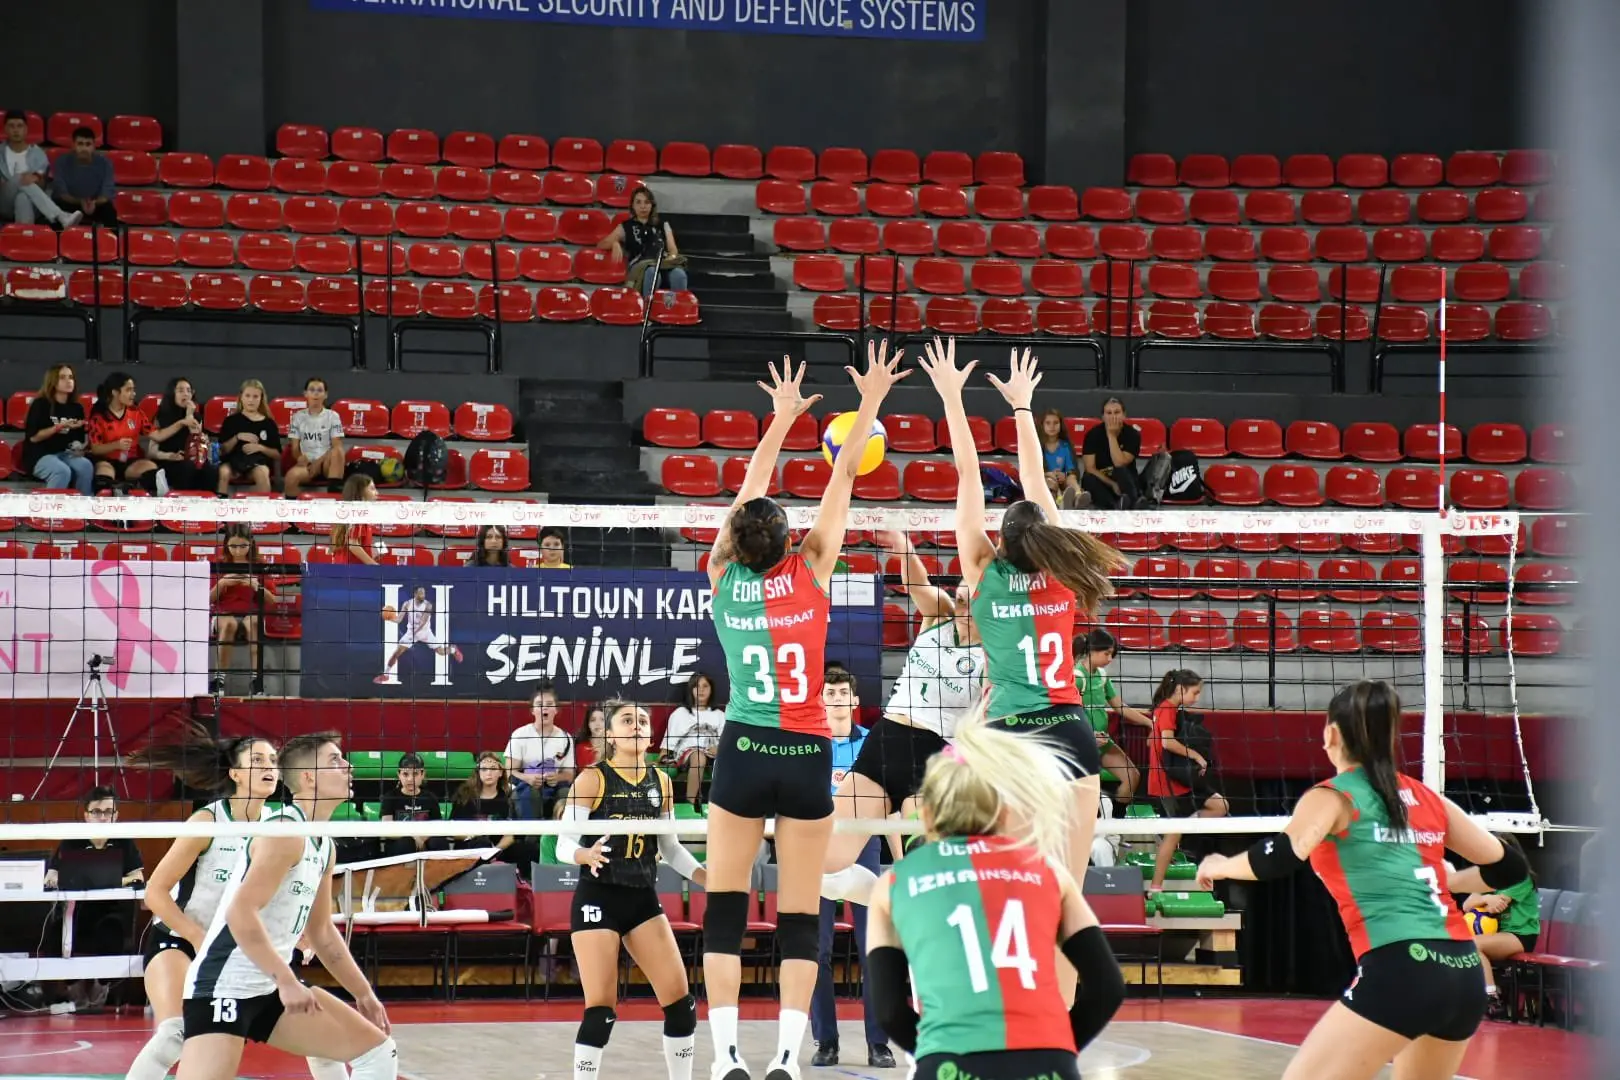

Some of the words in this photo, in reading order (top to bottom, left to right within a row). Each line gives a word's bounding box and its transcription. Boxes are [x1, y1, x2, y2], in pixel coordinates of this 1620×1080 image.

[670, 0, 725, 22] AND
[735, 0, 849, 27] DEFENCE
[860, 0, 976, 33] SYSTEMS
[1171, 464, 1195, 487] NIKE
[44, 503, 63, 511] TVF
[107, 505, 127, 513] TVF
[229, 507, 248, 515] TVF
[291, 508, 309, 516] TVF
[351, 509, 369, 517] TVF
[526, 511, 544, 519] TVF
[584, 513, 600, 521] TVF
[641, 513, 659, 521] TVF
[698, 514, 715, 522] TVF
[866, 516, 884, 524] TVF
[923, 516, 940, 524] TVF
[1090, 517, 1107, 525] TVF
[1200, 518, 1217, 526] TVF
[1313, 518, 1329, 526] TVF
[1467, 515, 1501, 530] TVF
[732, 581, 762, 602] EDA
[764, 573, 795, 600] SAY
[487, 584, 644, 620] HILLTOWN
[991, 601, 1035, 619] İZKA
[485, 625, 702, 686] SENİNLE
[1017, 632, 1066, 689] 12
[742, 642, 808, 704] 33
[1019, 713, 1081, 726] VACUSERA
[752, 742, 822, 756] VACUSERA
[1413, 866, 1448, 917] 7
[581, 904, 602, 923] 15
[946, 899, 1038, 993] 14
[209, 998, 237, 1023] 13
